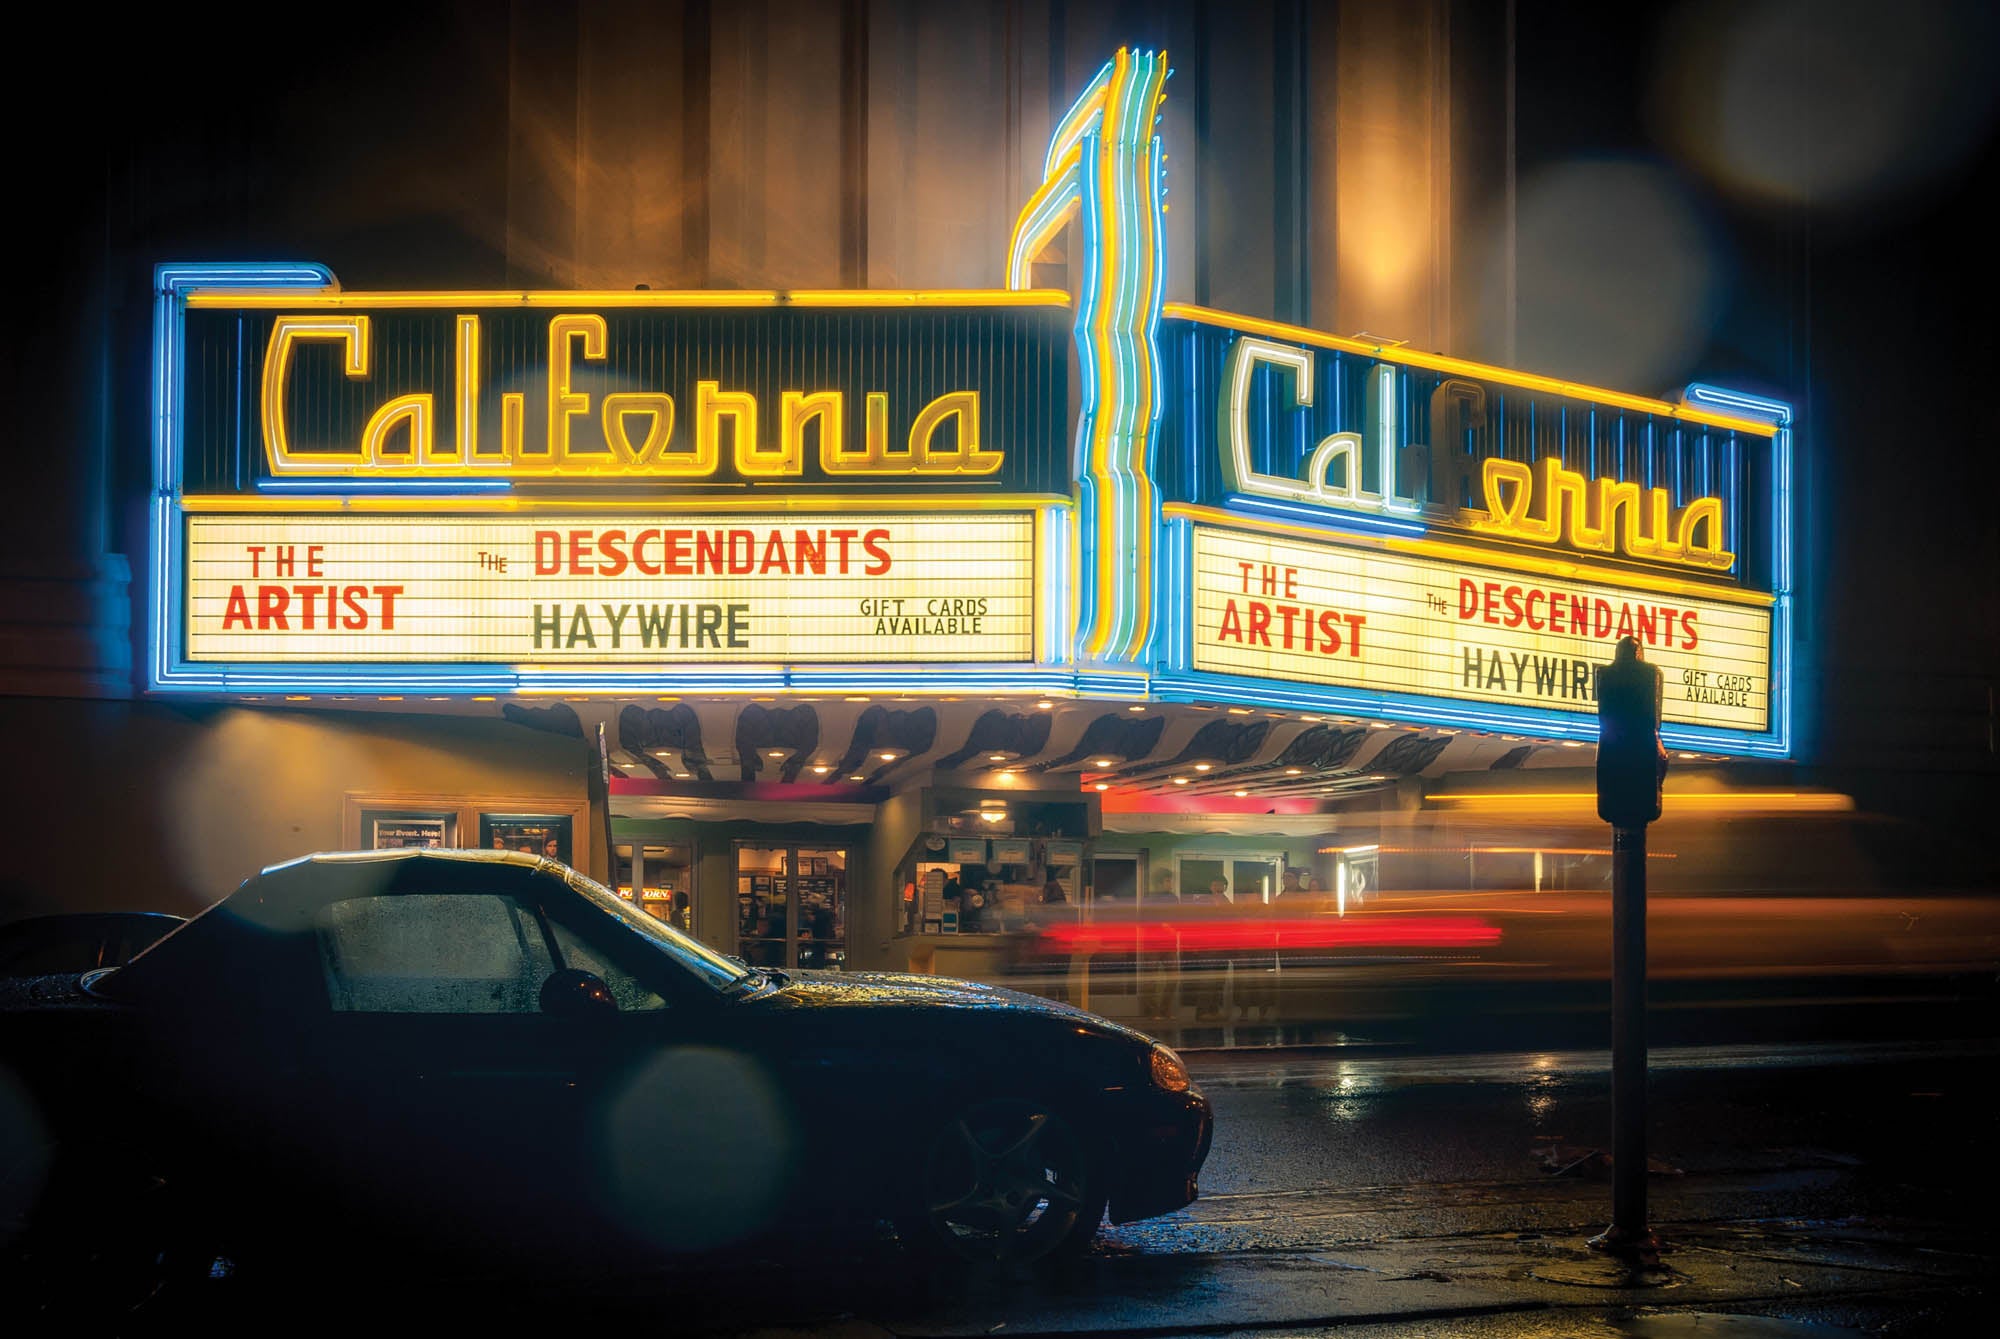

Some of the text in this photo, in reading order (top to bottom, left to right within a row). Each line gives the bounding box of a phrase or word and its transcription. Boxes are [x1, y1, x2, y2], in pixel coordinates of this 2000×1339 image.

[261, 314, 1005, 477] California
[247, 546, 325, 577] THE
[479, 529, 892, 577] THE DESCENDANTS
[1238, 562, 1298, 599] THE
[222, 585, 404, 630] ARTIST
[533, 604, 749, 649] HAYWIRE
[860, 598, 988, 617] GIFT CARDS
[875, 617, 982, 635] AVAILABLE
[1218, 598, 1367, 658] ARTIST
[1426, 578, 1699, 650] THE DESCENDANTS
[1463, 646, 1600, 702] HAYWIR
[1682, 670, 1752, 692] GIFT CARDS
[1686, 687, 1747, 707] AVAILABLE
[619, 889, 669, 898] POORN
